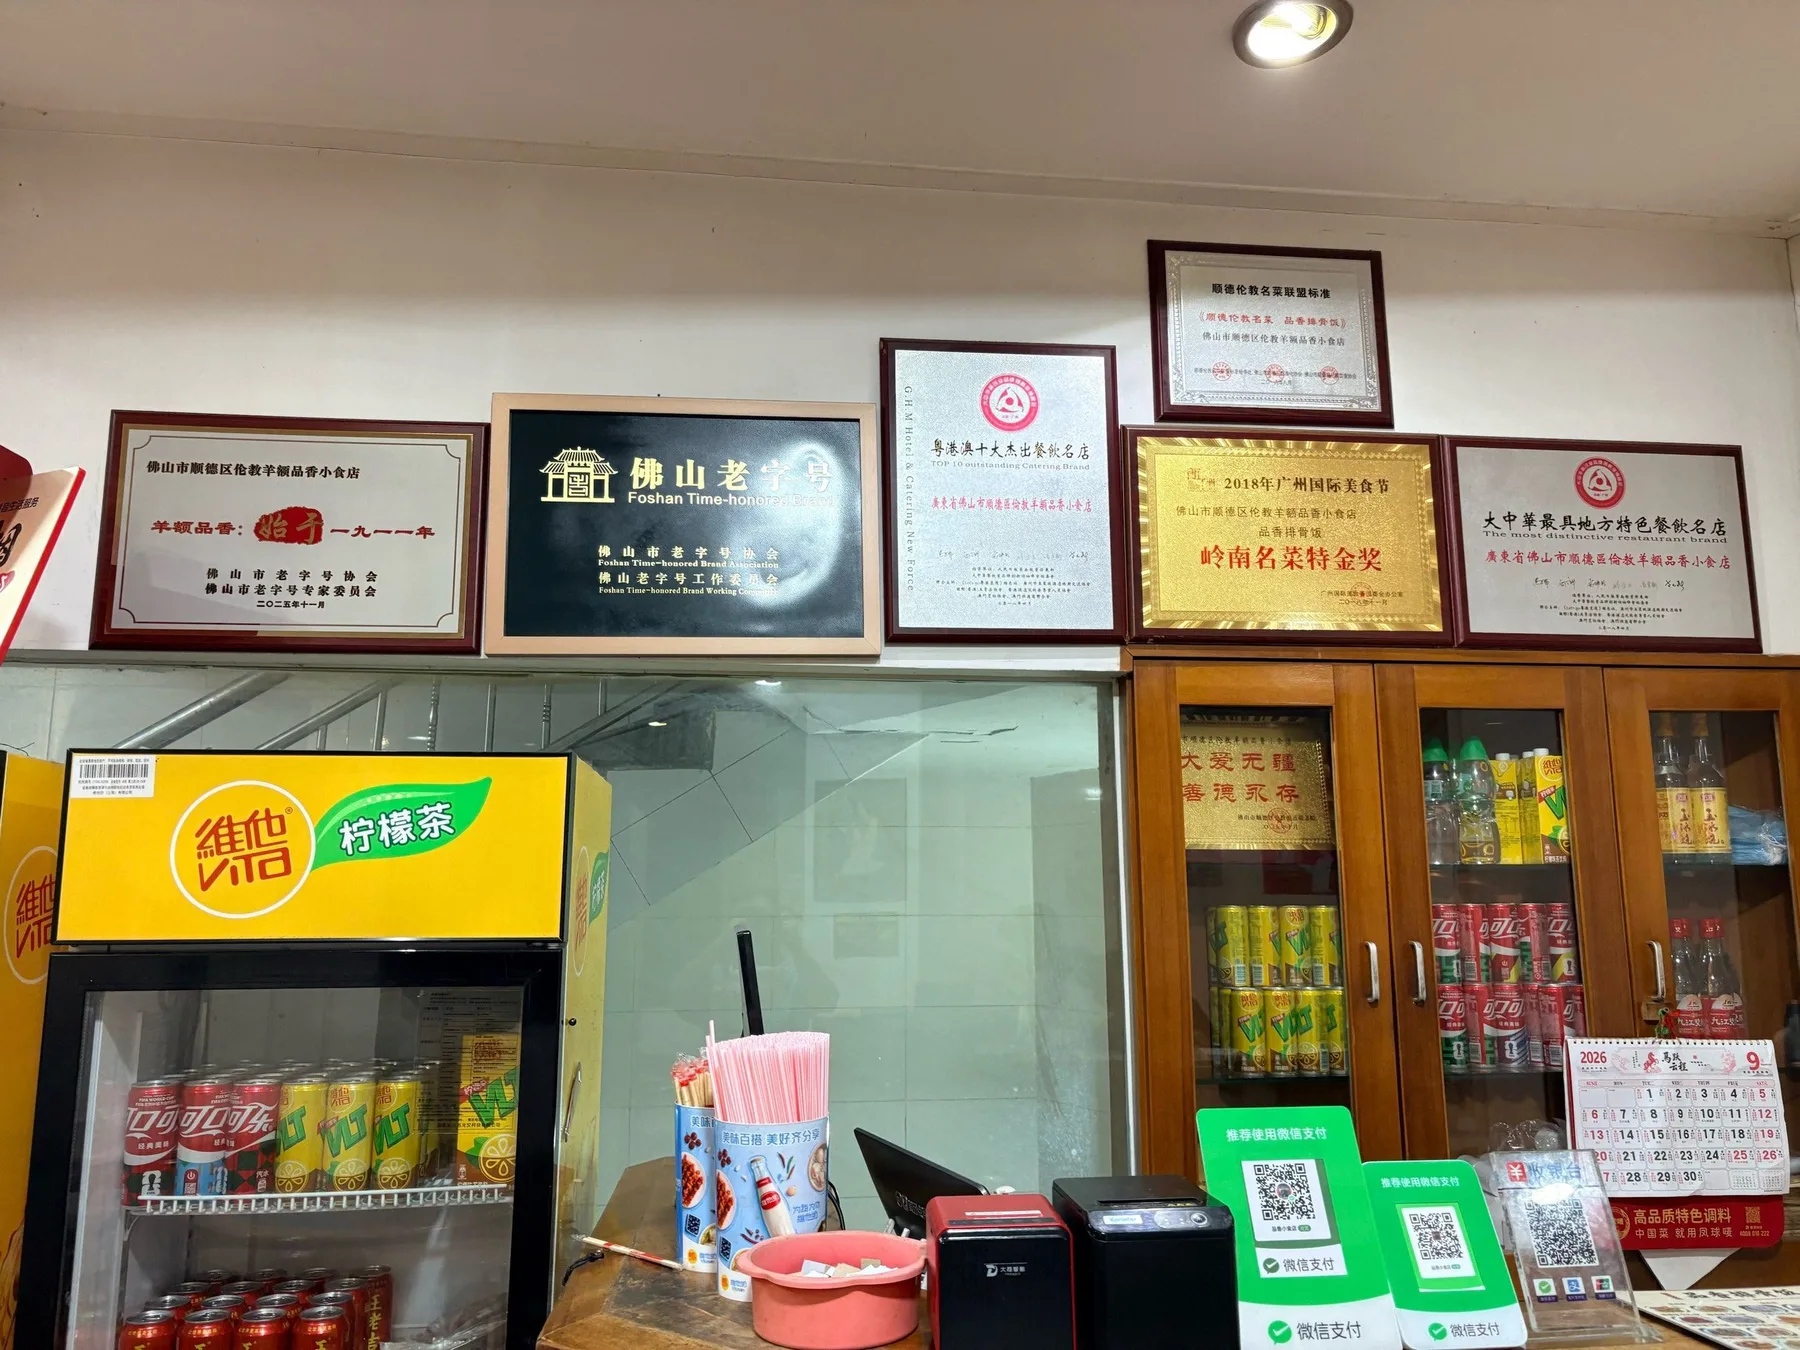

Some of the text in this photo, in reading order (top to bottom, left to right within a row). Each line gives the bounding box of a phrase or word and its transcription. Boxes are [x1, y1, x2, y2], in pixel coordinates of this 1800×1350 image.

[1211, 283, 1331, 299] 顺德伦教名菜联盟标准
[1199, 312, 1347, 329] 《顺德伦教名菜 品香排骨饭》
[1202, 331, 1345, 347] 佛山市顺德区伦教羊额品香小食店
[905, 427, 913, 457] Hotel
[147, 461, 360, 479] 佛山市顺德区伦教羊额品香小食店
[629, 456, 834, 493] 佛山老字号
[1224, 476, 1390, 495] 2018年广州国际美食节
[628, 491, 684, 505] Foshan
[687, 492, 788, 506] Time-honored
[905, 476, 914, 525] Catering
[1176, 505, 1357, 520] 佛山市顺德区伦教羊额品香小食店
[330, 525, 435, 539] 一九一一年
[1259, 526, 1322, 539] 品香排骨饭
[1483, 530, 1507, 538] The
[1547, 532, 1614, 541] distinctive
[1617, 534, 1687, 543] restaurant
[1690, 536, 1727, 544] brand
[907, 531, 916, 553] New
[598, 545, 779, 560] 佛山市老字号协会
[1200, 544, 1383, 572] 岭南名菜特金奖
[598, 559, 629, 567] Foshan
[729, 561, 779, 569] Association
[206, 568, 378, 583] 佛山市老字号协会
[599, 571, 779, 586] 佛山老字号工作委员会
[907, 560, 916, 591] Force
[205, 583, 377, 597] 佛山市老字号专家委员会
[706, 587, 737, 596] Working
[1181, 752, 1296, 772] 大爱无疆
[1182, 783, 1299, 803] 善德永存
[339, 802, 455, 856] 柠檬茶
[1580, 1052, 1607, 1064] 2026
[1747, 1052, 1760, 1071] 9
[1646, 1089, 1766, 1099] 1 2 3 4 5
[1591, 1109, 1772, 1119] 6 7 8 9 10 11 12
[723, 1131, 820, 1146] 美味百搭 美好齐分享
[1226, 1127, 1327, 1142] 推荐使用微信支付
[1590, 1129, 1774, 1140] 13 14 15 16 17 18 19
[1623, 1151, 1637, 1161] 21
[1654, 1151, 1668, 1160] 22
[1680, 1151, 1693, 1160] 23
[1706, 1151, 1720, 1160] 24
[1733, 1150, 1748, 1160] 25
[1763, 1150, 1777, 1160] 26
[1381, 1176, 1460, 1188] 推荐使用微信支付
[1626, 1172, 1641, 1182] 28
[1657, 1172, 1671, 1182] 29
[1683, 1171, 1697, 1181] 30
[1633, 1207, 1731, 1224] 高品质特色调料
[1635, 1228, 1669, 1239] 中国菜
[1283, 1257, 1334, 1273] 微信支付
[1297, 1321, 1361, 1340] 微信支付
[1450, 1322, 1500, 1338] 微信支付
